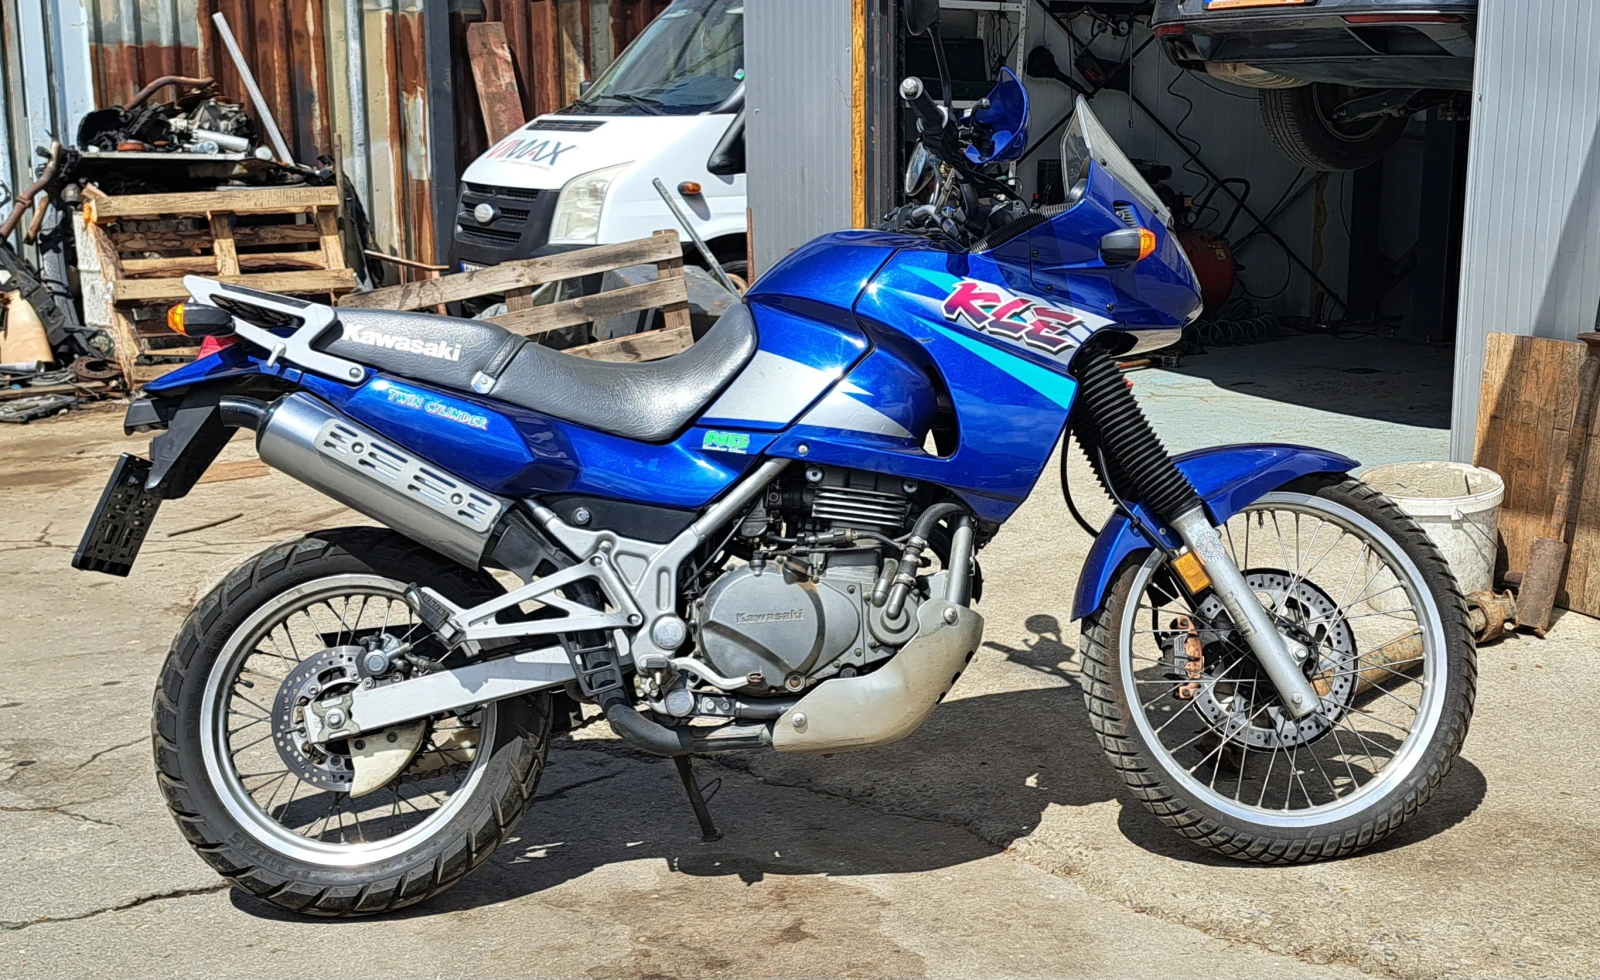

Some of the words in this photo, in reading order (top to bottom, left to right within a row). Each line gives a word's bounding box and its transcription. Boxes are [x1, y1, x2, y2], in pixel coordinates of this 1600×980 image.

[486, 139, 577, 166] VIMAX
[941, 280, 1084, 355] KLE
[341, 323, 462, 362] Kawasaki
[387, 388, 424, 410] TWIN
[424, 400, 488, 430] CYLINDER
[736, 609, 804, 624] Kawasaki
[228, 832, 286, 874] MITAS
